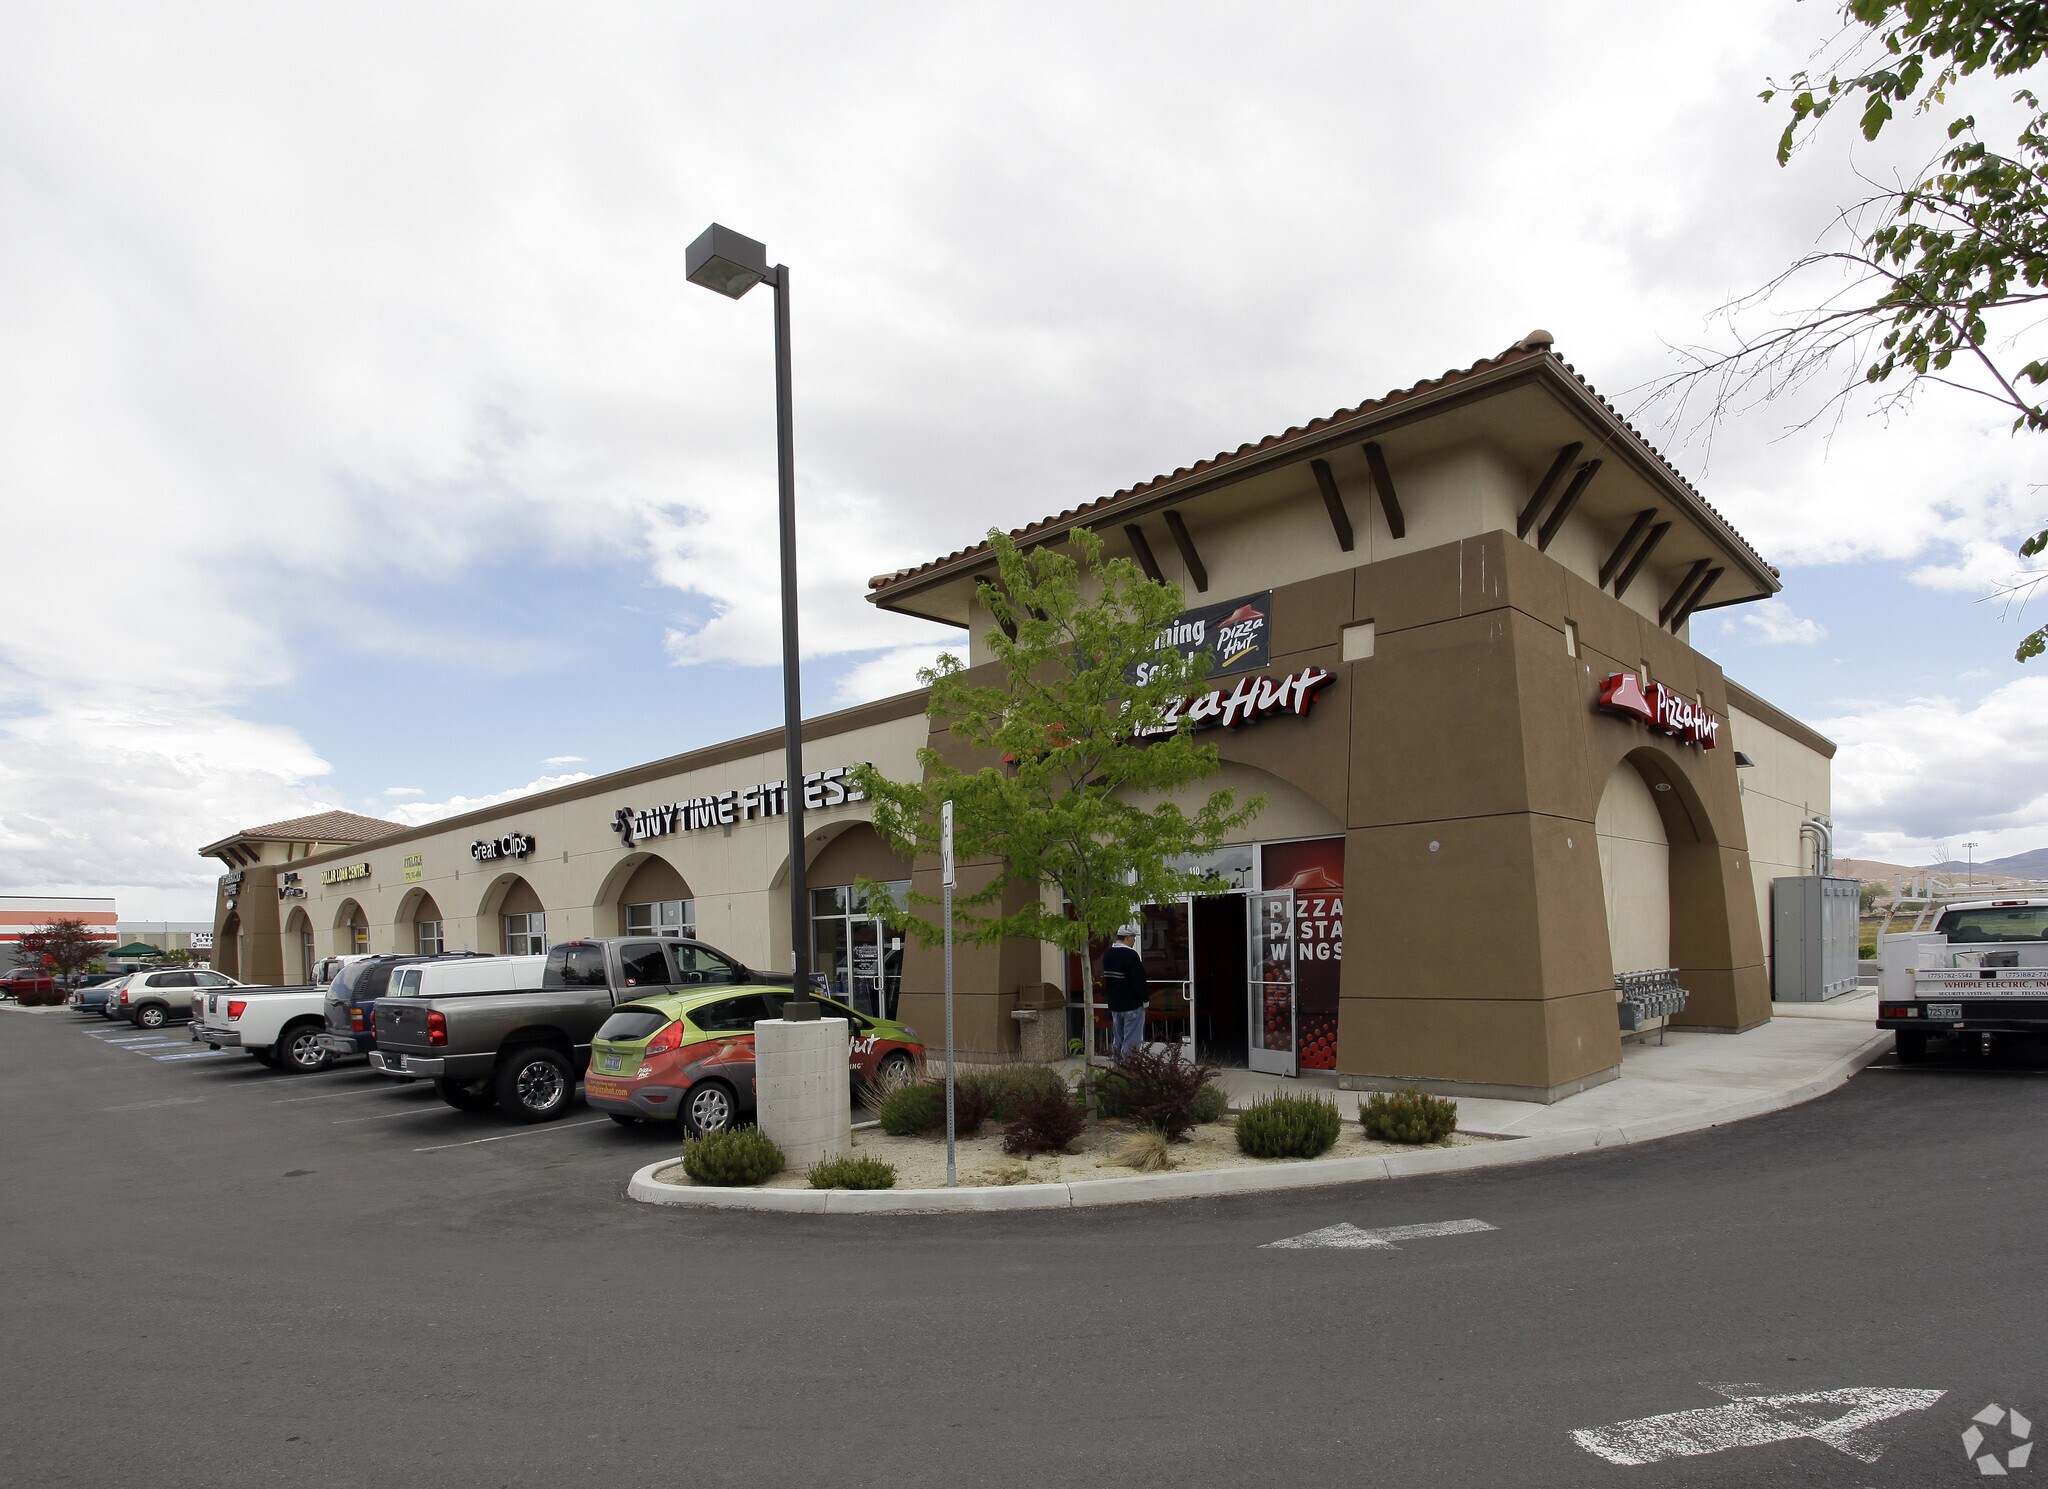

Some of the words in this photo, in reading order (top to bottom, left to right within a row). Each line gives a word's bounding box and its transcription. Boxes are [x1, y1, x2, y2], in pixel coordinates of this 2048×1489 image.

[1217, 618, 1264, 651] Pizza
[1223, 632, 1258, 660] Hut
[1221, 666, 1328, 727] Hut
[633, 790, 736, 840] ANYTIME
[469, 840, 499, 861] Great
[501, 832, 528, 859] Clips
[1270, 898, 1344, 918] PIZZA
[1270, 942, 1343, 961] WNGS
[1944, 981, 1983, 989] WHIPPLE
[1986, 981, 2032, 989] ELECTRIC,
